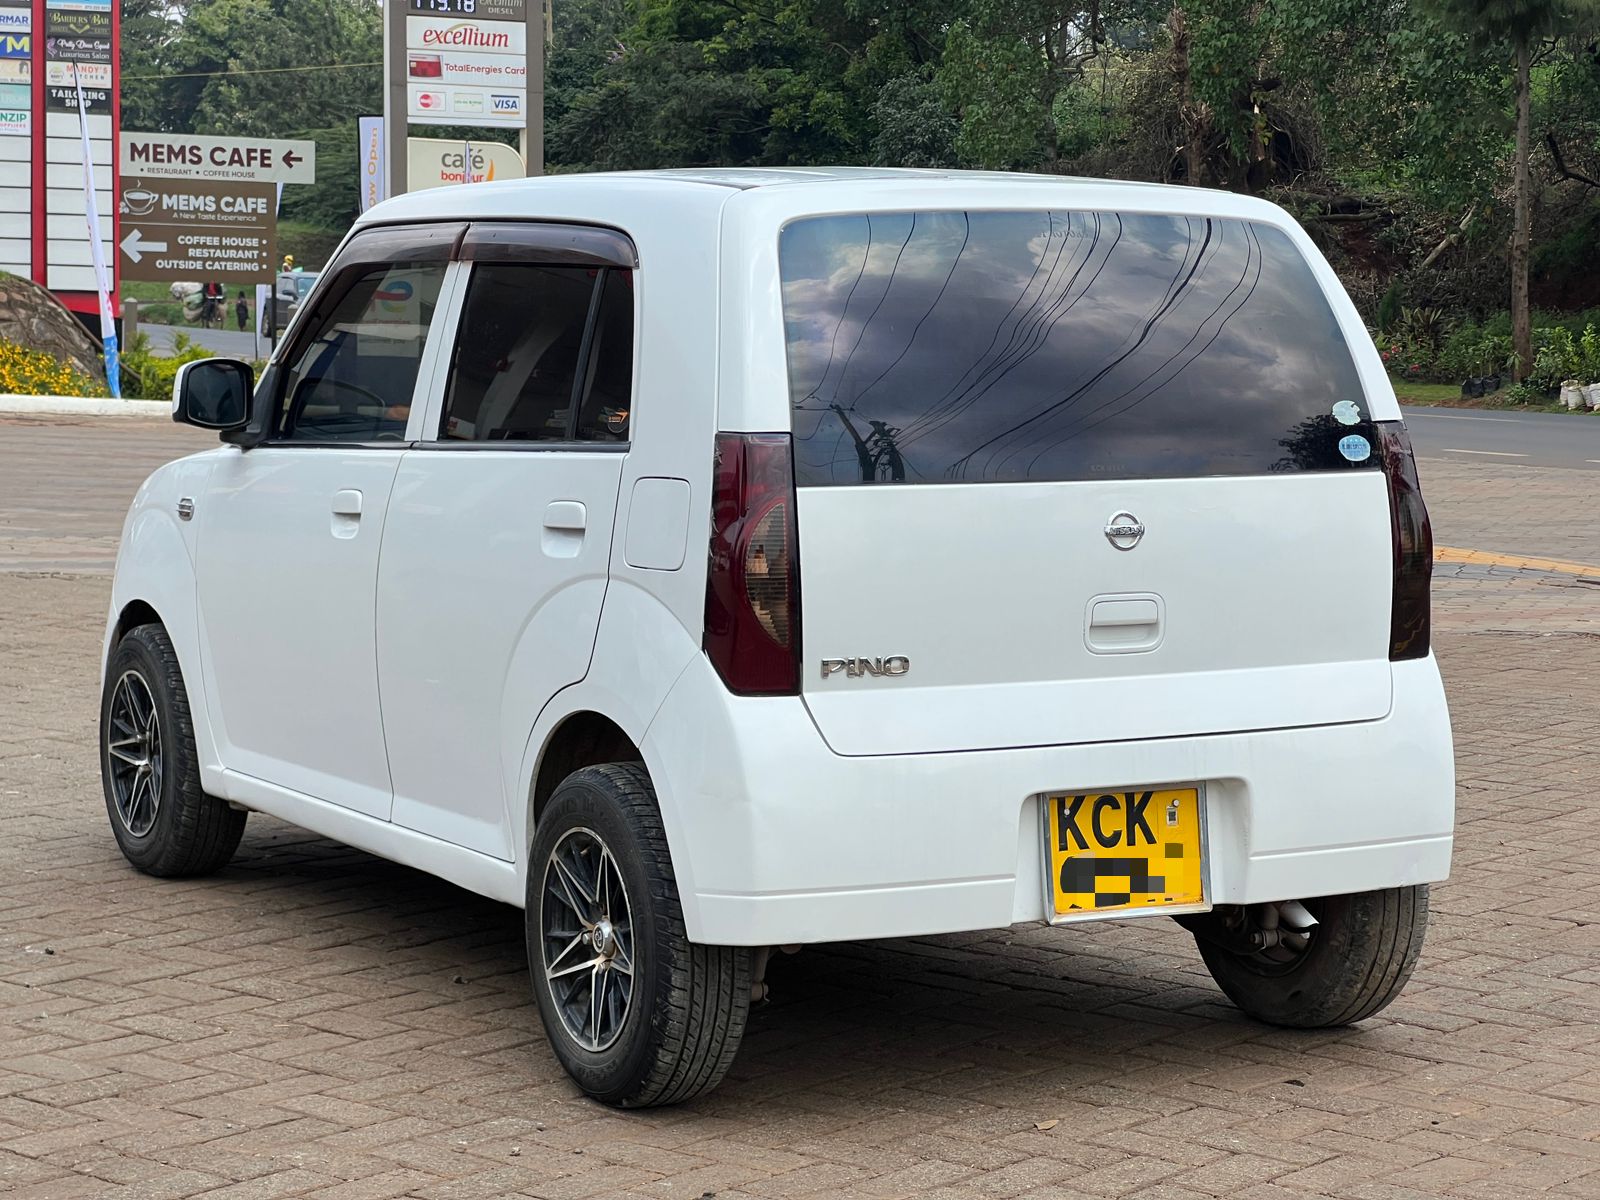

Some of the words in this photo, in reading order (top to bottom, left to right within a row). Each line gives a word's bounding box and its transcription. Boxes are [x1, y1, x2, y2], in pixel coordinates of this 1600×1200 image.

[488, 7, 514, 15] DIESEL
[423, 27, 509, 48] excellium
[445, 63, 502, 75] TotalEnergies
[505, 67, 526, 75] Card
[65, 99, 92, 108] SHP
[494, 100, 518, 109] VISA
[130, 142, 203, 165] MEMS
[209, 147, 272, 168] CAFE
[147, 167, 192, 176] RESTAURANT
[441, 170, 484, 184] bonjur
[369, 181, 377, 208] ow
[162, 194, 216, 212] MEMS
[220, 196, 268, 214] CAFE
[197, 213, 216, 221] Taste
[217, 214, 257, 222] Experience
[177, 235, 220, 246] COFFEE
[222, 237, 260, 247] HOUSE
[188, 248, 259, 259] RESTAURANT
[155, 259, 203, 270] OUTSIDE
[205, 261, 260, 272] CATERING
[1109, 526, 1142, 535] NISSAN
[821, 655, 910, 679] PINO
[1057, 791, 1157, 852] KCK
